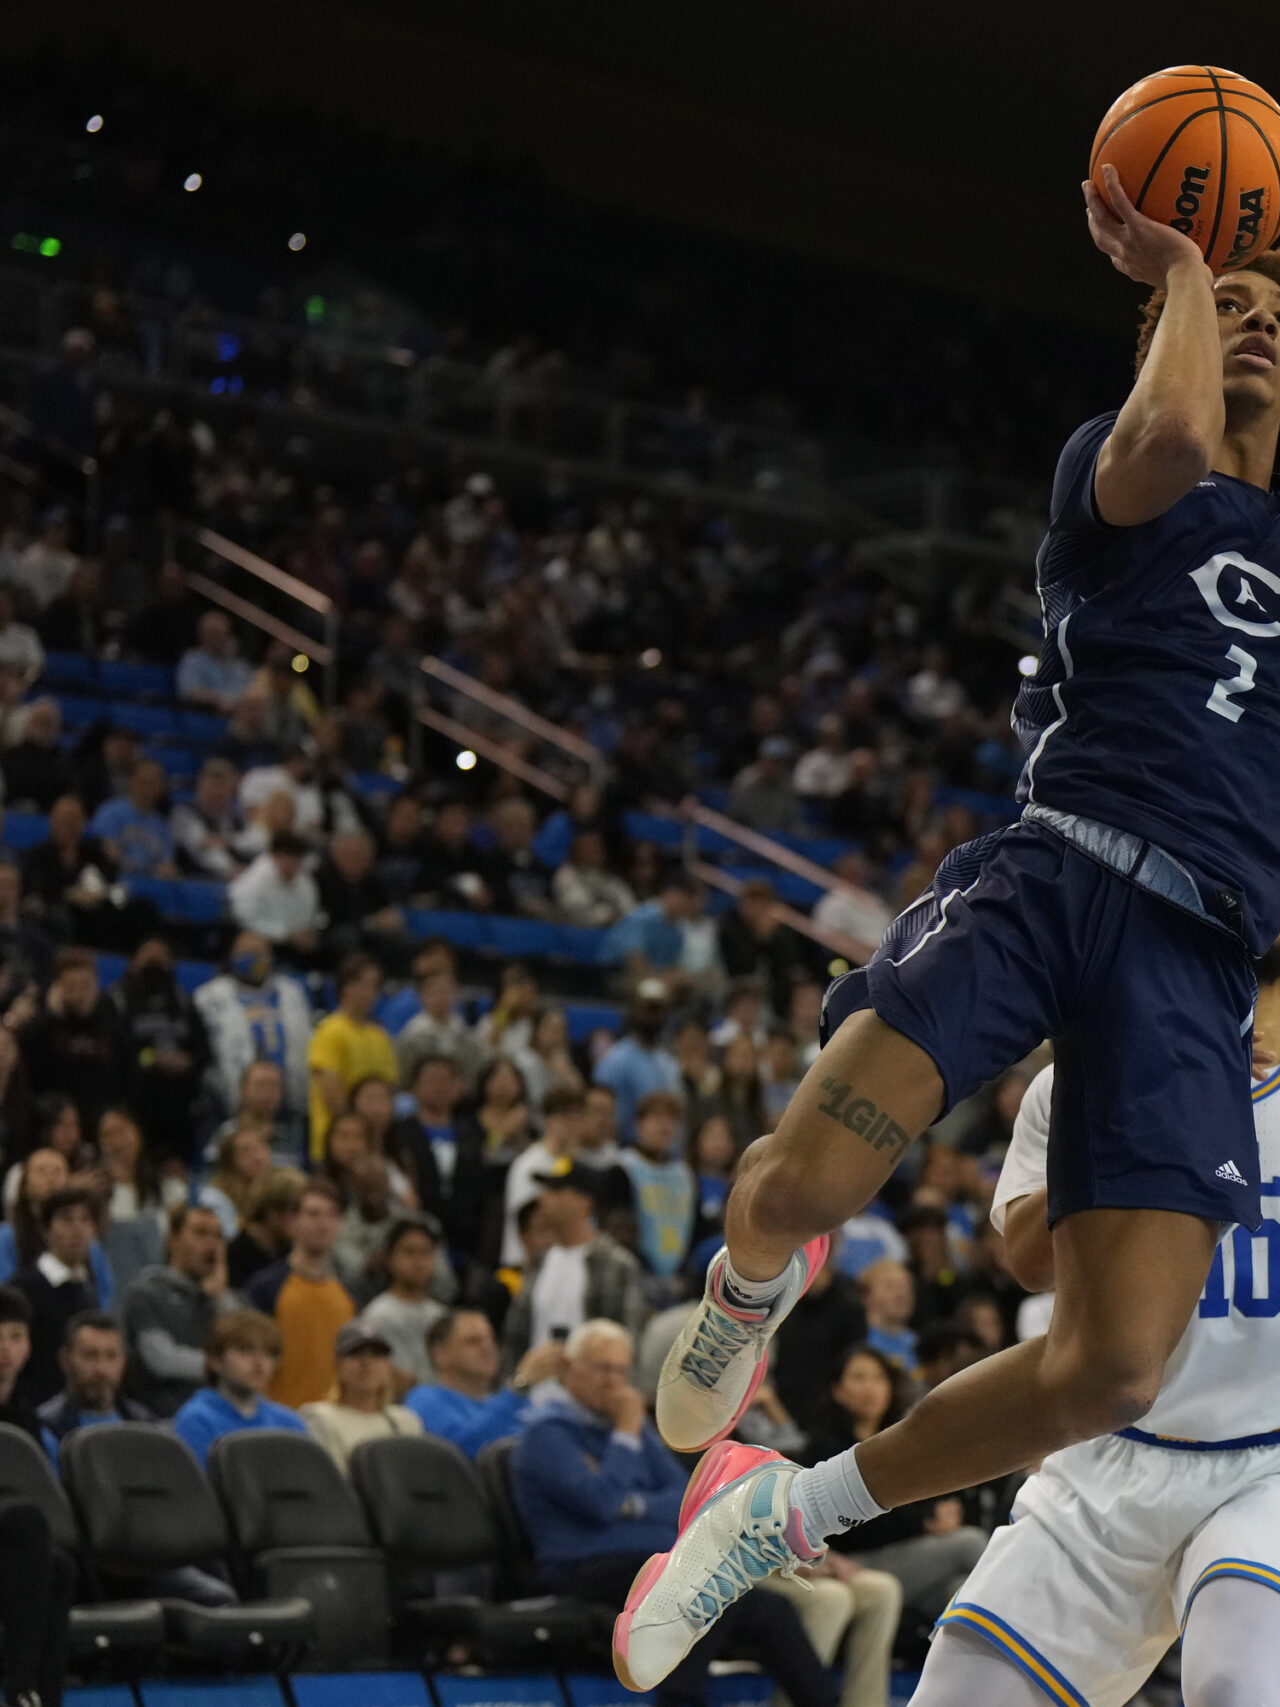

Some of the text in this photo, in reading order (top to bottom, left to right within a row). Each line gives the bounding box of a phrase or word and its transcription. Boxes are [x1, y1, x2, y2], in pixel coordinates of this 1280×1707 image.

[1221, 187, 1265, 268] NCAA
[1206, 644, 1258, 723] 2
[1214, 1169, 1248, 1187] adidas
